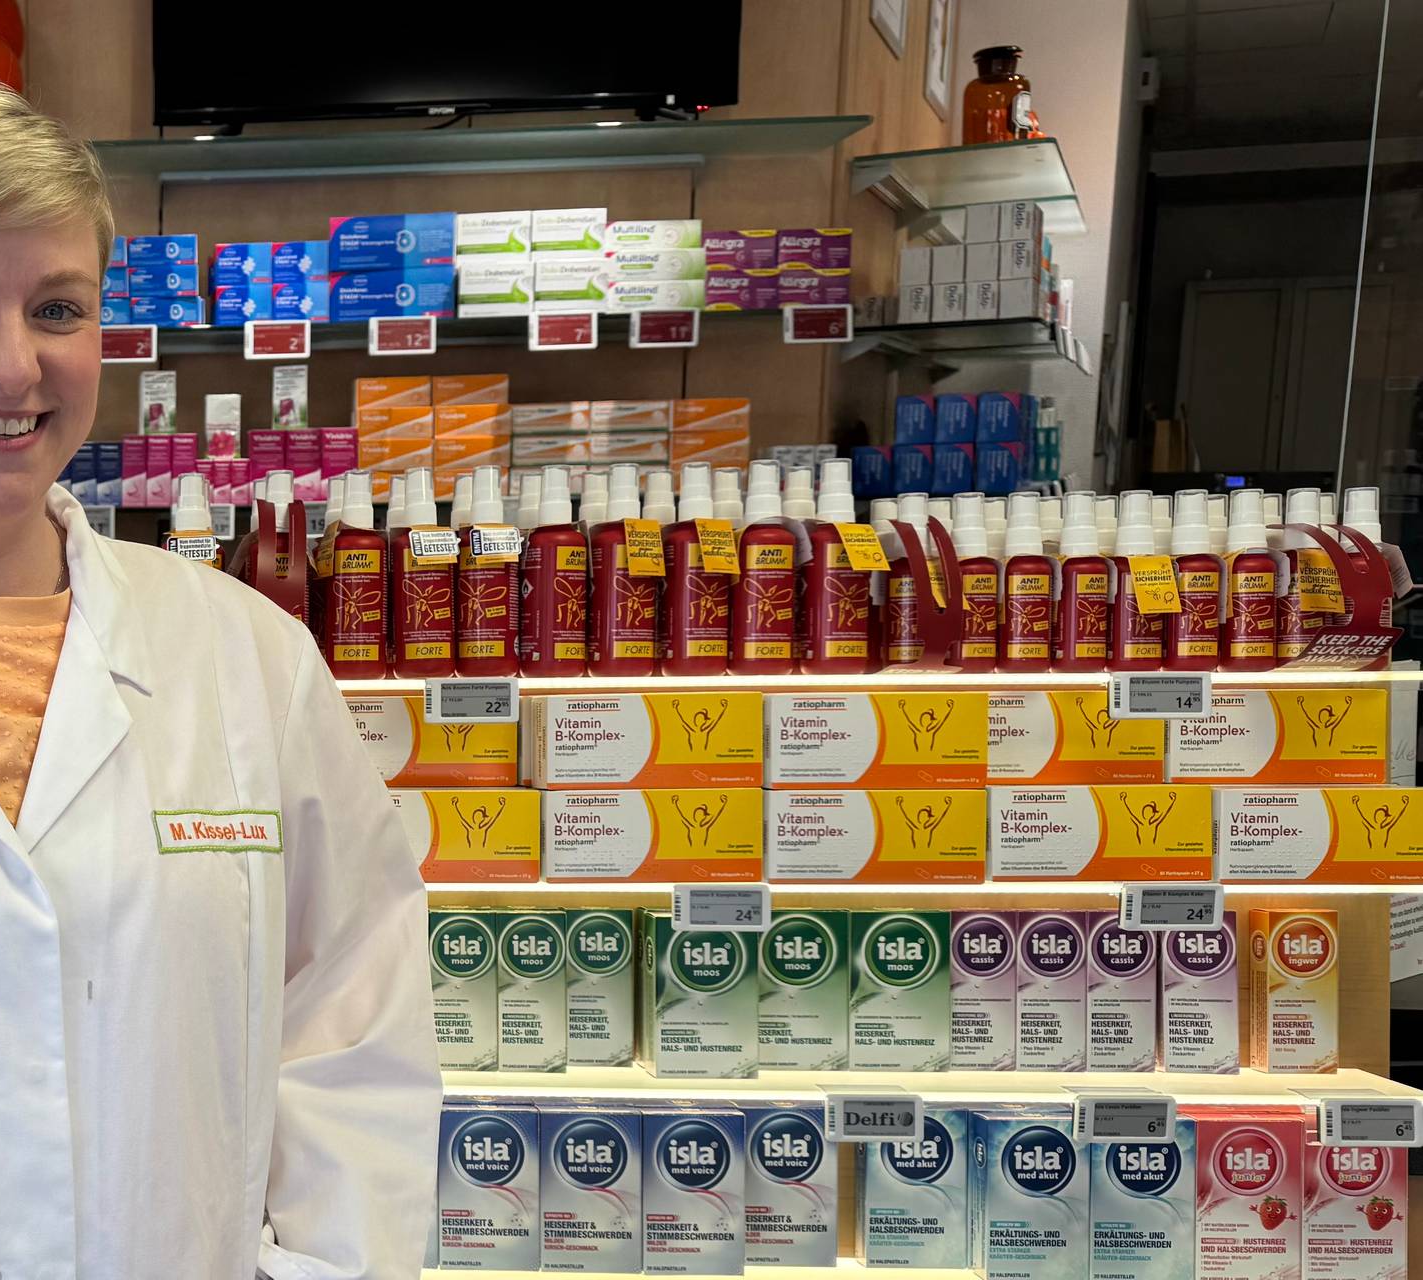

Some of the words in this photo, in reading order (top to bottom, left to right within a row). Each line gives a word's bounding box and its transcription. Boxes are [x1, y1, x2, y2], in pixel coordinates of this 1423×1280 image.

[704, 237, 744, 249] Allegra
[709, 277, 748, 288] Allegra
[424, 543, 455, 552] GETESTET
[483, 542, 517, 551] GETESTET
[345, 553, 368, 561] ANTI
[1020, 577, 1040, 586] ANTI
[1243, 576, 1264, 584] ANTI
[1316, 635, 1359, 645] KEEP
[1359, 636, 1393, 646] THE
[342, 649, 371, 657] FORTE
[466, 645, 495, 654] FORTE
[698, 643, 724, 653] FORTE
[972, 646, 993, 656] FORTE
[1135, 647, 1160, 656] FORTE
[1246, 646, 1270, 655] FORTE
[1308, 646, 1384, 655] SUCKERS
[567, 701, 619, 712] ratiopharm
[794, 700, 845, 710] ratiopharm
[555, 718, 602, 730] Vitamin
[781, 717, 827, 728] Vitamin
[555, 730, 625, 744] B-Komplex-
[780, 730, 851, 742] B-Komplex-
[791, 797, 842, 807] ratiopharm
[1245, 795, 1297, 806] ratiopharm
[777, 813, 824, 824] Vitamin
[1231, 813, 1279, 824] Vitamin
[169, 823, 192, 840] M.
[192, 821, 267, 840] Kissel-Lux
[1001, 822, 1072, 835] B-Komplex-
[1231, 826, 1302, 838] B-Komplex-
[443, 936, 481, 955] isla
[579, 933, 618, 953] isla
[963, 934, 1003, 954] isla
[1102, 935, 1142, 955] isla
[1179, 934, 1221, 954] isla
[775, 937, 821, 960] isla
[451, 958, 473, 966] moos
[588, 954, 610, 962] moos
[971, 956, 995, 964] cassis
[1111, 956, 1134, 964] cassis
[1187, 956, 1213, 964] cassis
[1289, 957, 1318, 966] ingwer
[887, 963, 914, 971] moos
[1273, 1037, 1315, 1045] HUSTENREIZ
[844, 1112, 896, 1126] Delfi
[464, 1136, 510, 1161] isla
[669, 1140, 716, 1166] isla
[1227, 1148, 1271, 1170] isla
[915, 1161, 936, 1169] akut
[671, 1167, 688, 1175] med
[691, 1167, 715, 1175] voice
[1232, 1172, 1266, 1184] junior
[442, 1219, 484, 1227] HEISERKEIT
[486, 1218, 493, 1227] &
[869, 1217, 920, 1225] ERKÄLTUNGS-
[442, 1227, 529, 1237] STIMMBESCHWERDEN
[869, 1225, 944, 1234] HALSBESCHWERDEN
[990, 1229, 1041, 1238] ERKÄLTUNGS-
[1043, 1230, 1059, 1238] UND
[647, 1232, 734, 1241] STIMMBESCHWERDEN
[990, 1238, 1066, 1247] HALSBESCHWERDEN
[1201, 1246, 1215, 1254] UND
[1217, 1245, 1286, 1254] HALSBESCHWERDEN
